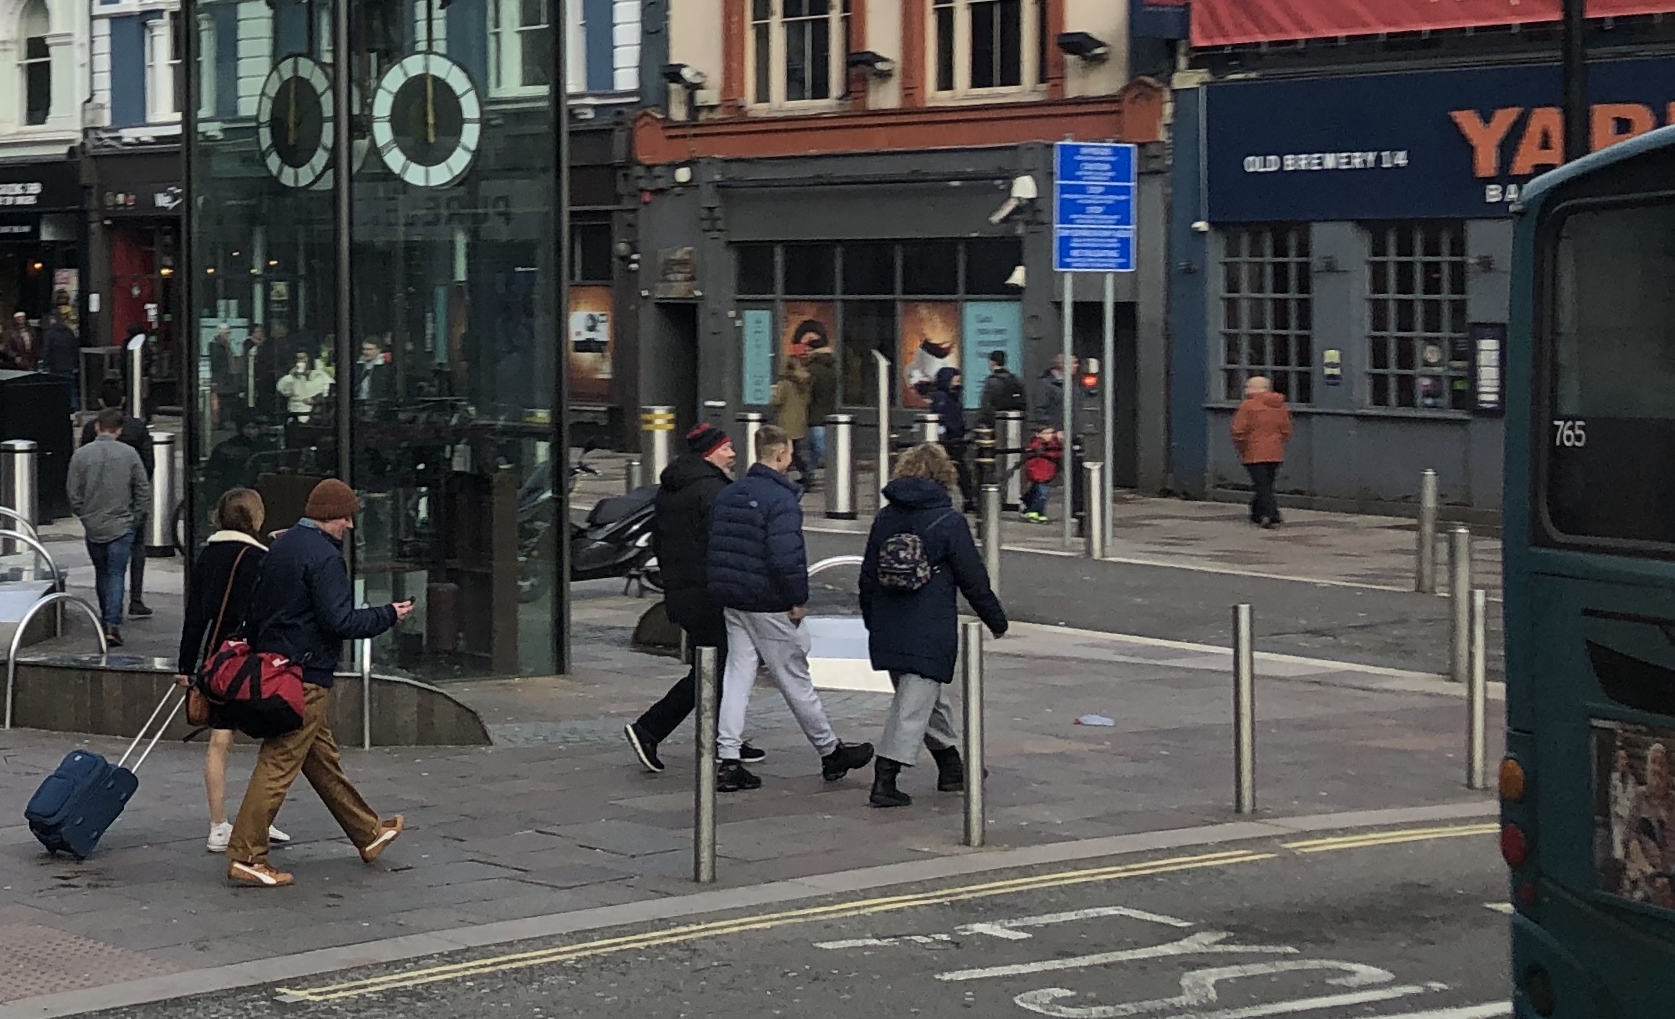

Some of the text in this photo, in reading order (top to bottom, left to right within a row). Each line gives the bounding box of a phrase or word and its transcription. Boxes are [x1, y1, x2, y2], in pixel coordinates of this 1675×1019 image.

[1243, 150, 1409, 172] OLD BREWERY 14
[1553, 420, 1586, 447] 765
